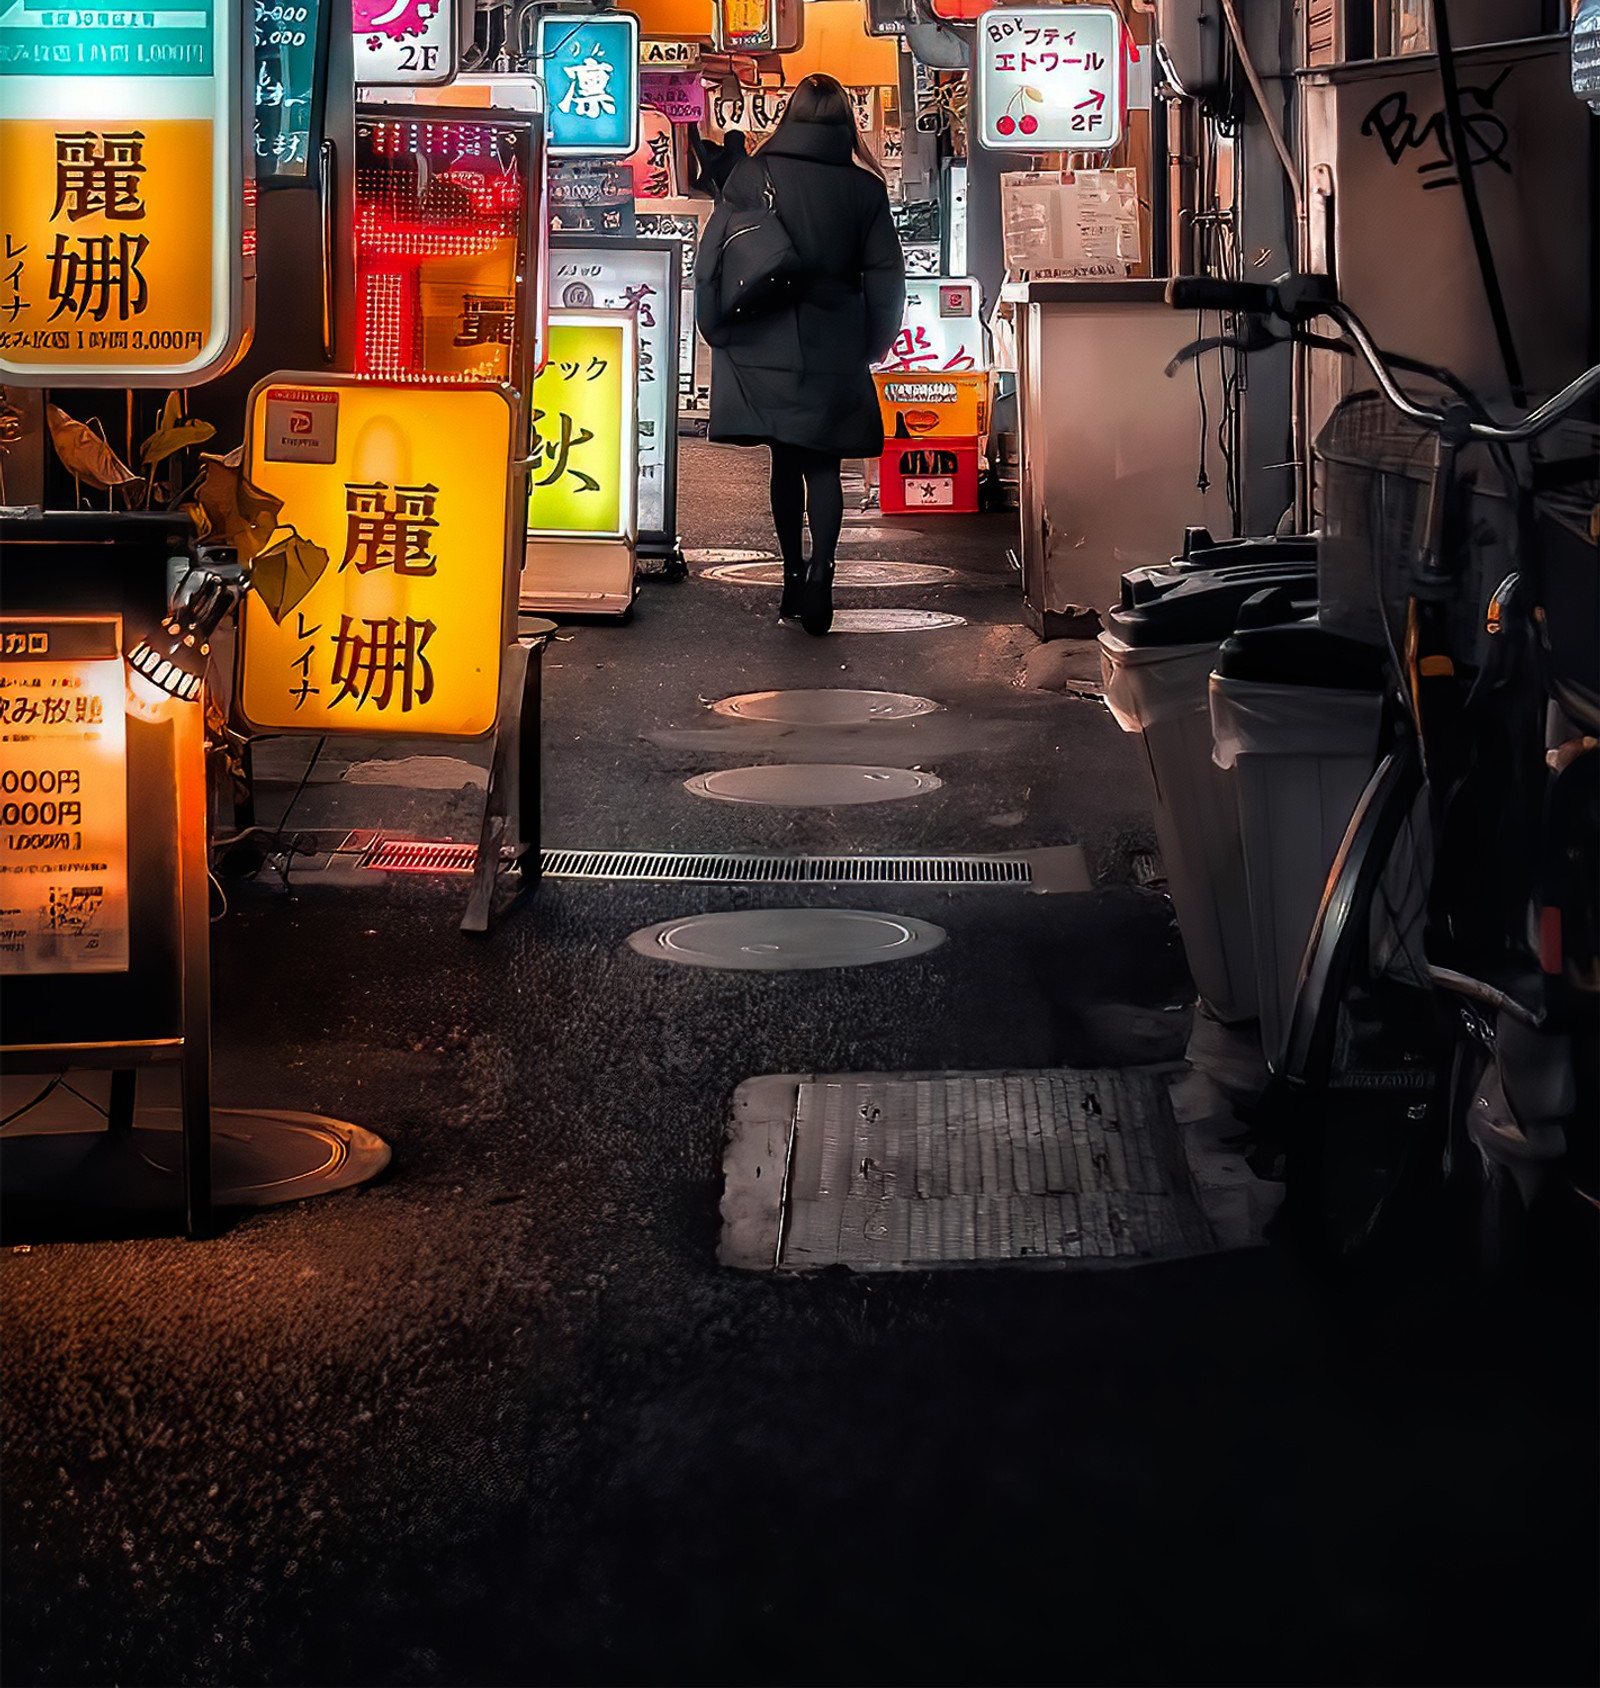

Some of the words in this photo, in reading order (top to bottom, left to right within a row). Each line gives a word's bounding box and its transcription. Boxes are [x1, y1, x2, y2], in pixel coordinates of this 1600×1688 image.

[397, 45, 439, 71] 2F
[649, 43, 689, 61] Ash
[995, 52, 1105, 72] エトワール
[1071, 114, 1103, 132] 2F
[46, 130, 150, 323] 麗娜
[1, 233, 31, 323] レイナ
[326, 481, 441, 713] 麗娜
[290, 612, 323, 711] レイナ
